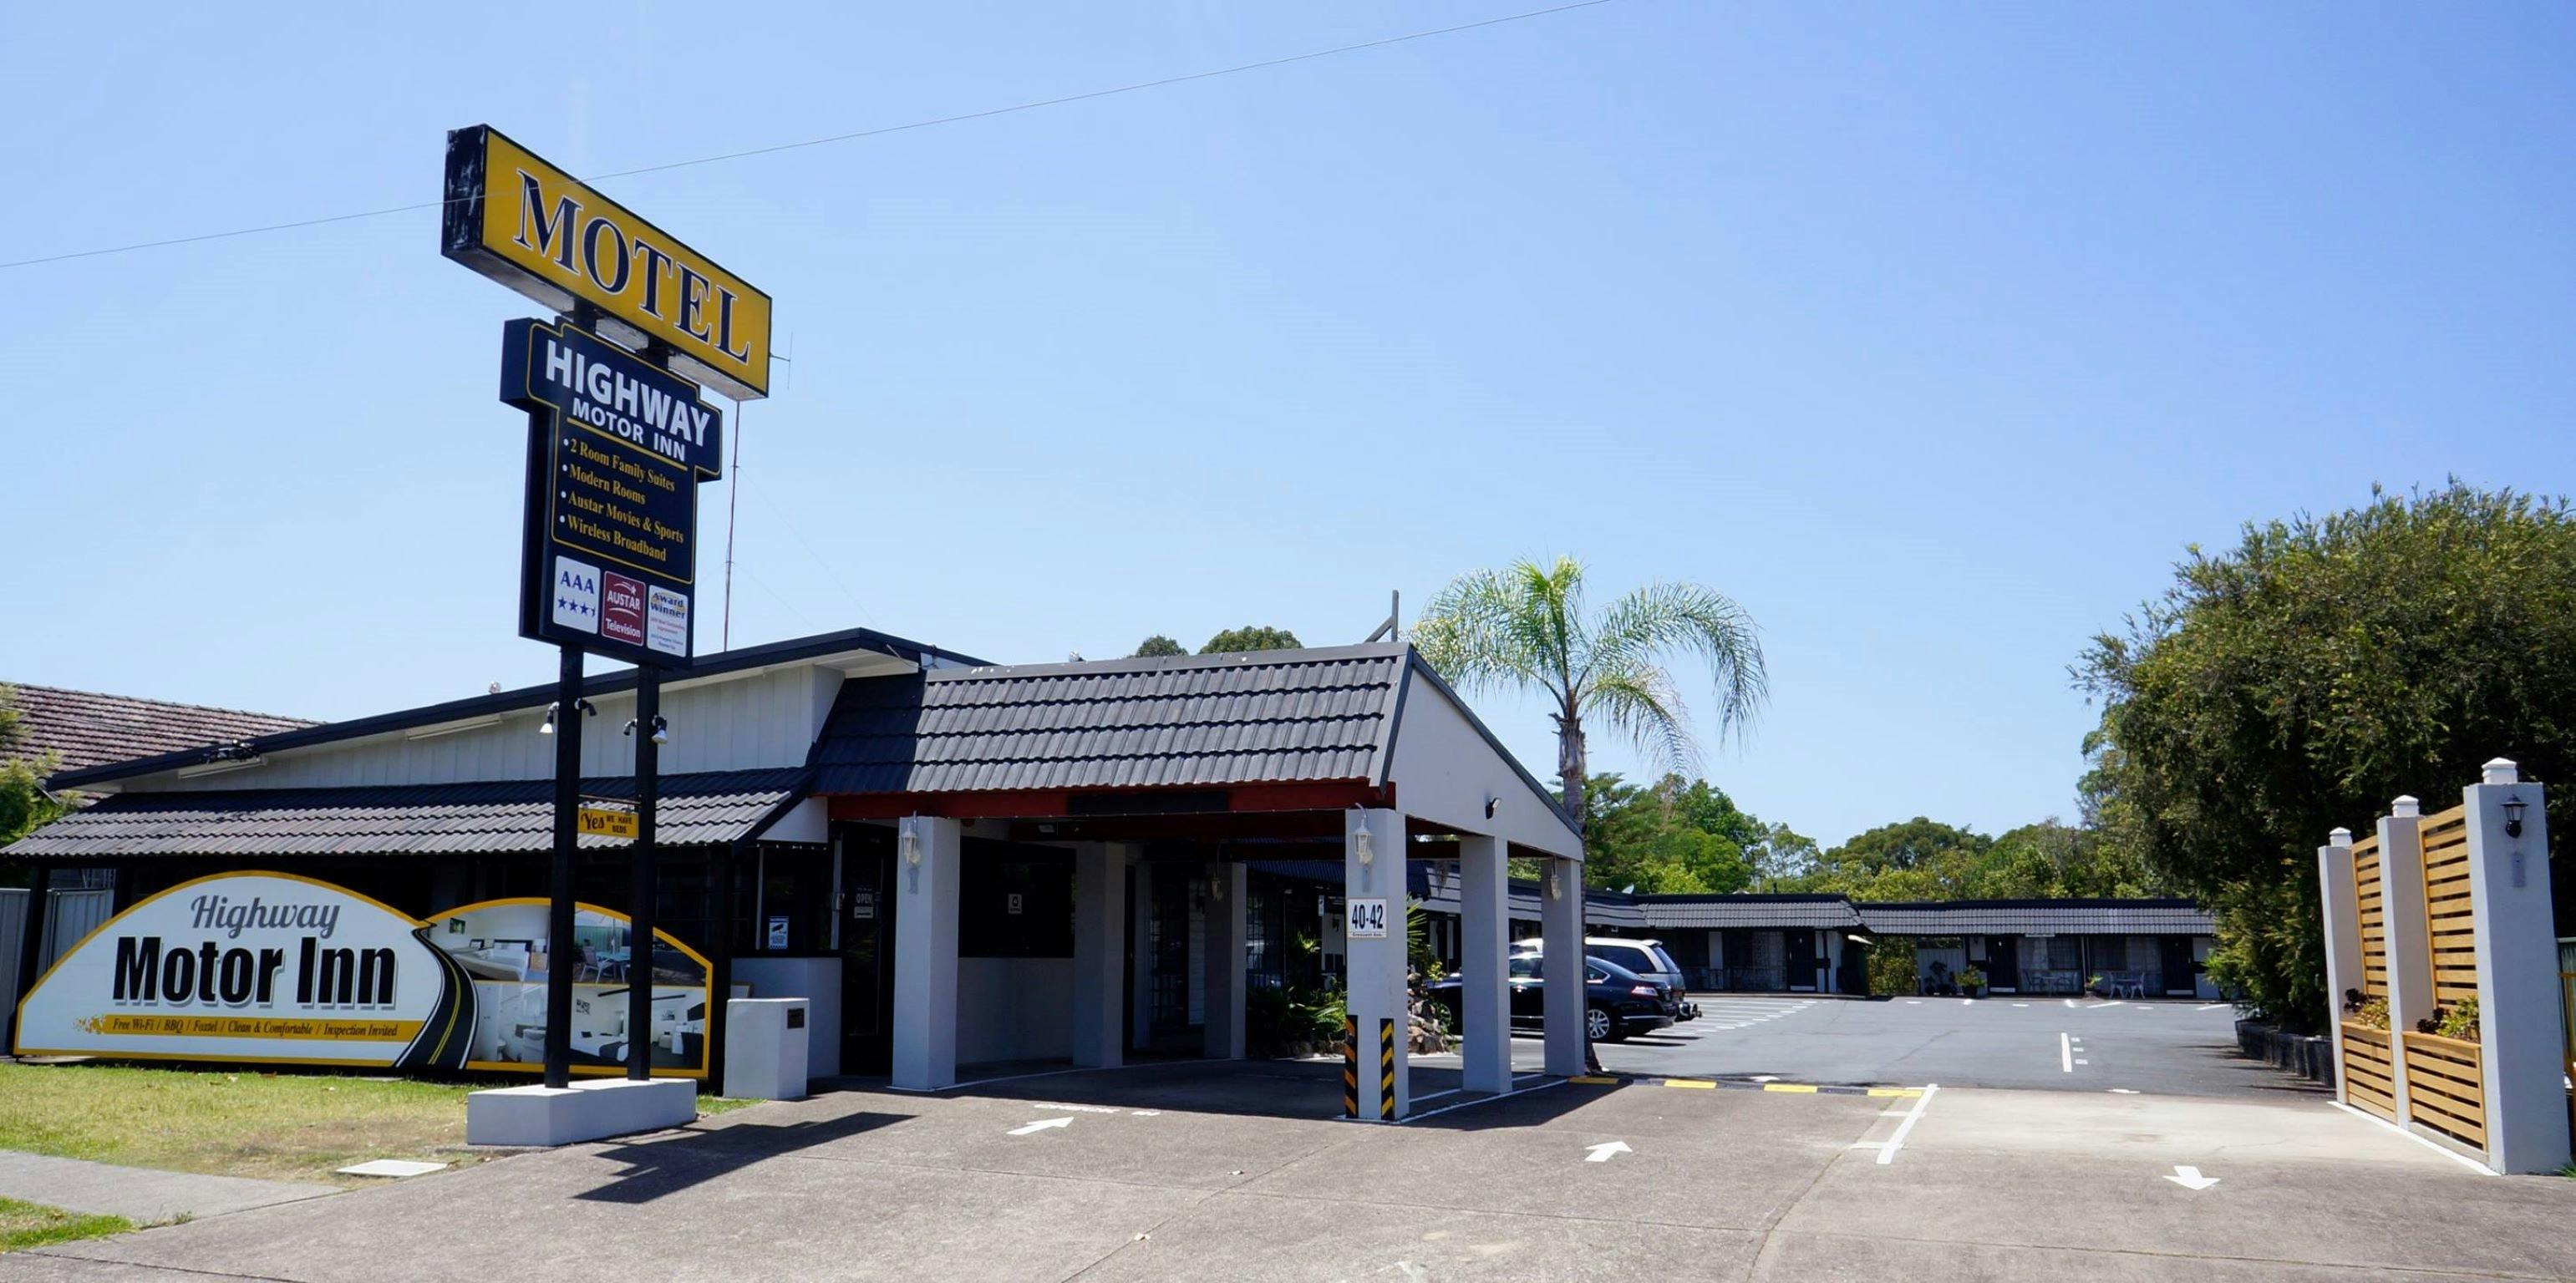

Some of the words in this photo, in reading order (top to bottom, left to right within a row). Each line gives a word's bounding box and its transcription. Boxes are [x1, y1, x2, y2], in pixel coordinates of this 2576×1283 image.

[512, 168, 751, 366] MOTEL
[546, 339, 710, 447] HIGHWAY
[572, 397, 644, 444] MOTOR
[653, 432, 685, 462] INN
[569, 463, 610, 492] Modern
[612, 482, 646, 505] Rooms
[570, 439, 577, 453] 2
[580, 441, 609, 466] Room
[612, 454, 646, 483] Family
[648, 469, 675, 491] Suites
[567, 514, 611, 542] Wireless
[613, 530, 667, 561] Broadband
[568, 490, 603, 515] Austar
[607, 503, 640, 528] Movies
[642, 517, 652, 532] &
[653, 520, 684, 543] Sports
[561, 571, 594, 594] AAA
[607, 590, 641, 611] AUSTAR
[653, 592, 683, 608] Award
[606, 617, 642, 638] Television
[650, 601, 685, 619] Winner
[580, 812, 605, 829] Yes
[191, 895, 341, 939] Highway
[1352, 904, 1383, 929] 40-42
[113, 936, 284, 1006] Motor
[297, 936, 396, 1007] Inn
[113, 1018, 129, 1030] Free
[132, 1018, 155, 1031] Wi-Fi
[164, 1019, 184, 1033] BBQ
[228, 1021, 252, 1033] Clean
[254, 1022, 261, 1033] &
[263, 1021, 312, 1037] Comfortable
[323, 1023, 366, 1038] Inspection
[368, 1024, 399, 1036] Invited
